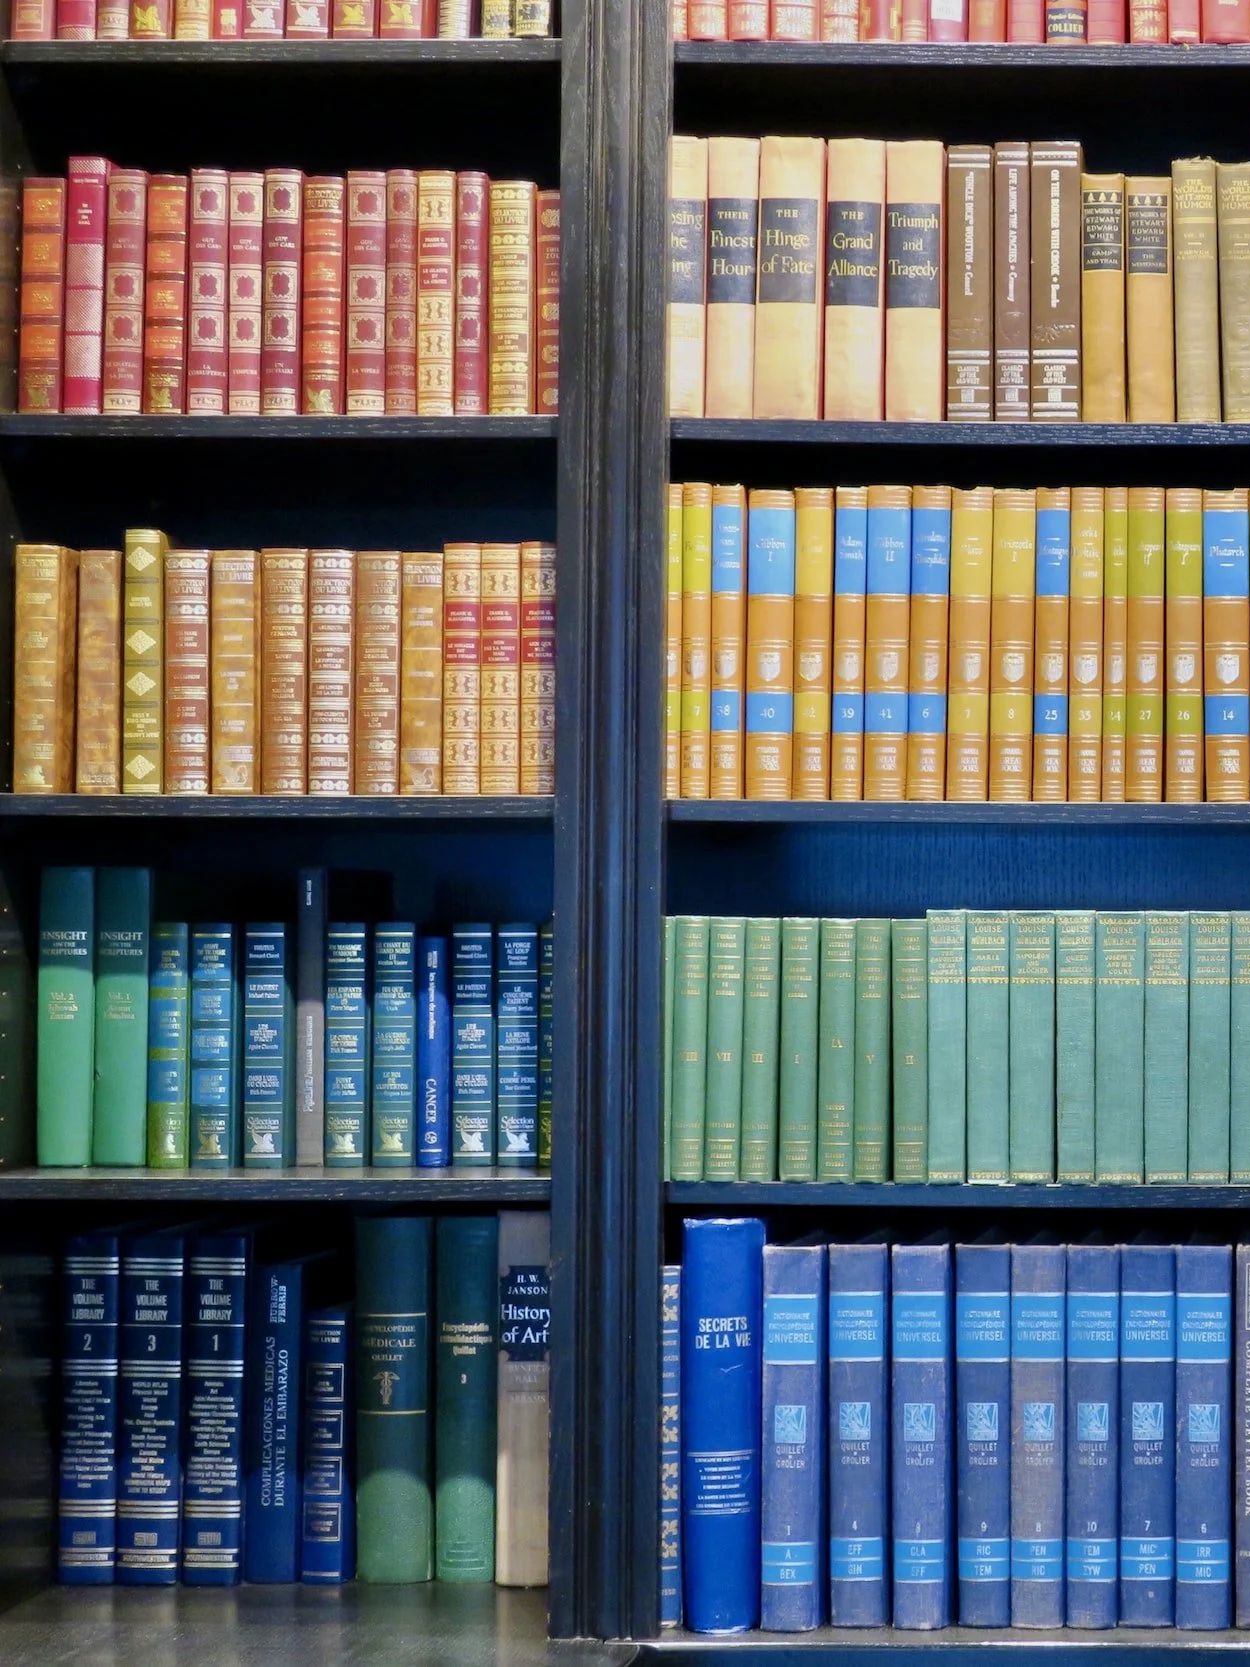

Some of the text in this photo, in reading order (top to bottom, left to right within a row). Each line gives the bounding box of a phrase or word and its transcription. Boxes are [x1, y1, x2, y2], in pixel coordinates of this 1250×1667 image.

[717, 210, 749, 220] THEIR
[775, 208, 799, 219] THE
[841, 210, 865, 221] THE
[887, 211, 939, 232] Triumph
[710, 230, 755, 248] Finest
[765, 229, 811, 248] Hinge
[832, 232, 874, 250] Grand
[902, 239, 924, 251] and
[711, 258, 752, 277] Hour
[761, 254, 815, 275] of Fate
[827, 258, 879, 278] Alliance
[887, 258, 939, 281] Tragedy
[1008, 708, 1014, 720] 8
[1044, 710, 1058, 720] 25
[100, 931, 142, 940] INSIGHT
[426, 1078, 437, 1124] CANCER
[208, 1278, 224, 1290] THE
[517, 1274, 539, 1283] H. W.
[144, 1280, 160, 1292] THE
[508, 1286, 548, 1295] JANSON
[136, 1294, 168, 1306] VOLUME
[200, 1294, 232, 1306] VOLUME
[136, 1310, 168, 1320] LIBRARY
[200, 1308, 232, 1320] LIBRARY
[500, 1304, 550, 1327] History
[698, 1316, 748, 1332] SECRETS
[502, 1326, 549, 1343] of Art
[696, 1332, 750, 1348] DE LA VIE
[1126, 1330, 1168, 1340] UNIVERSEL
[148, 1334, 156, 1352] 3
[212, 1334, 218, 1352] 1
[261, 1336, 276, 1506] COMPLICACIONES MEDICAS
[274, 1350, 288, 1508] DURANTE EL EMBARAZO
[1134, 1442, 1162, 1452] QUILLET
[1134, 1456, 1164, 1466] GROLIER
[1144, 1520, 1150, 1532] 7
[848, 1544, 862, 1556] EFF
[1140, 1544, 1156, 1554] MIC
[848, 1564, 862, 1574] GIN
[1138, 1562, 1156, 1574] PEN
